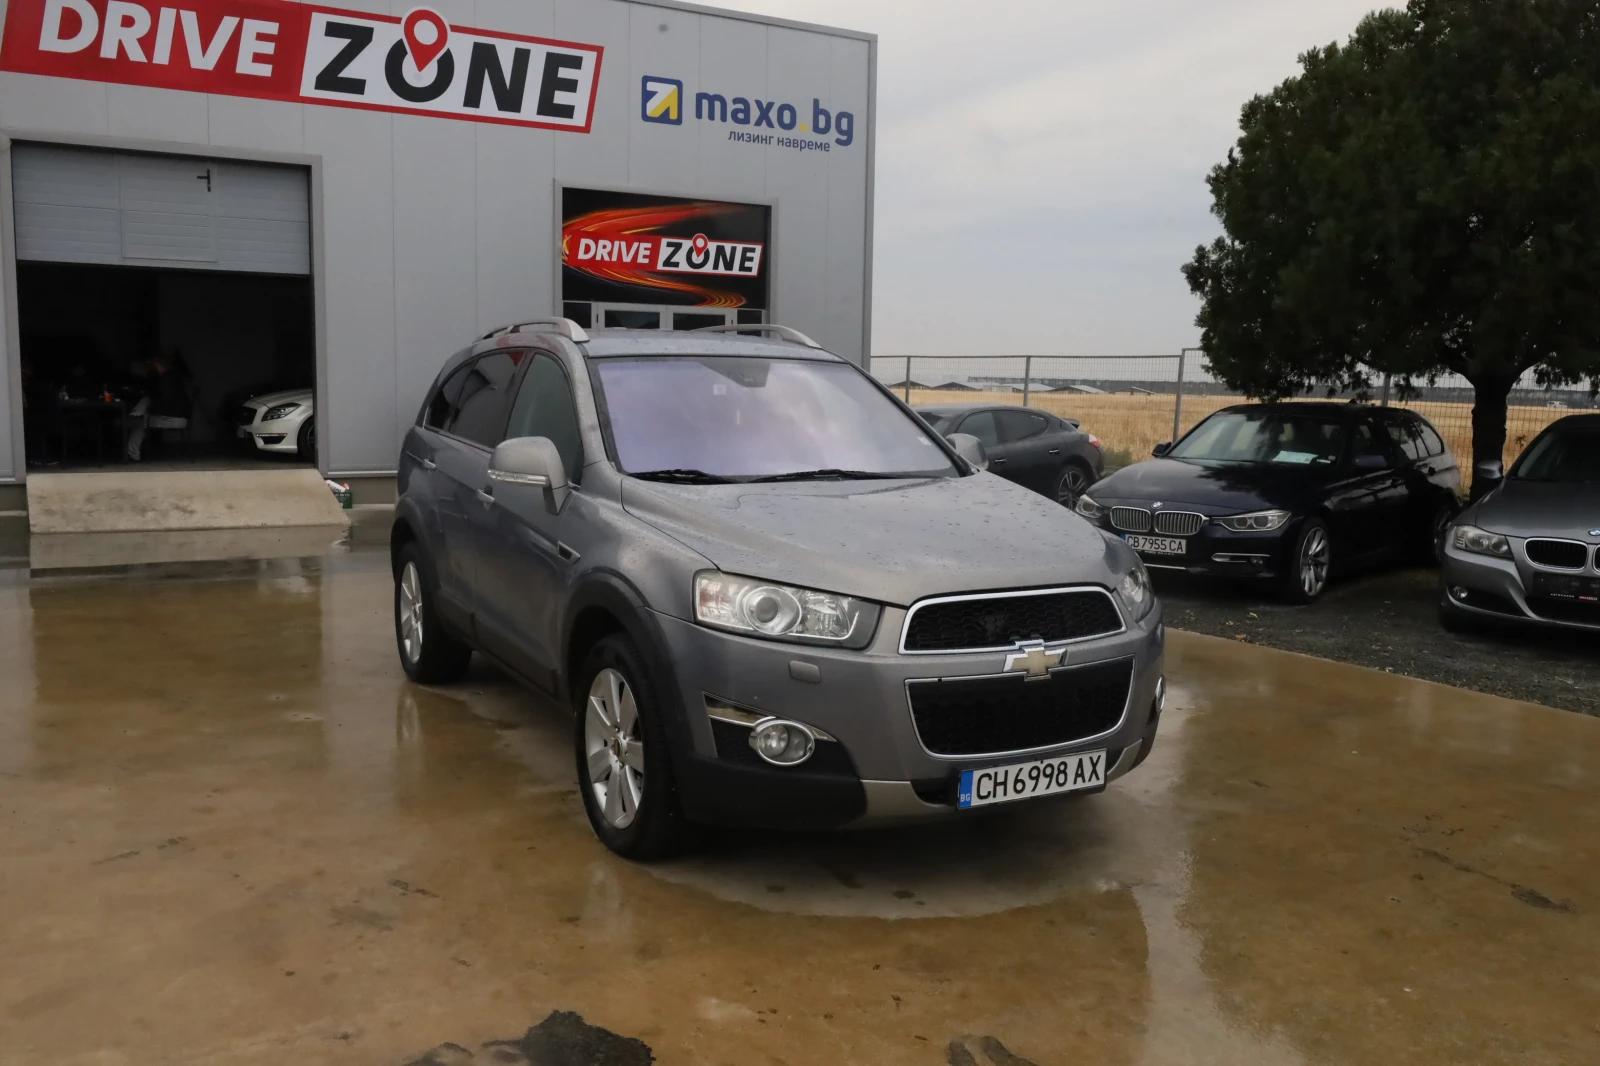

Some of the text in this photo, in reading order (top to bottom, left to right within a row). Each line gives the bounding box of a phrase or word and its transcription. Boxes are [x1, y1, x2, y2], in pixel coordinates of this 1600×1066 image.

[38, 0, 583, 119] DRIVE ZONE
[696, 92, 854, 146] maxo.bg
[728, 130, 830, 152] лизинг навреме
[577, 238, 756, 273] DRIVE ZONE
[1141, 537, 1167, 550] 7955
[1169, 540, 1184, 552] CA
[976, 754, 1102, 800] CH 6998 AX
[960, 793, 971, 802] BG
